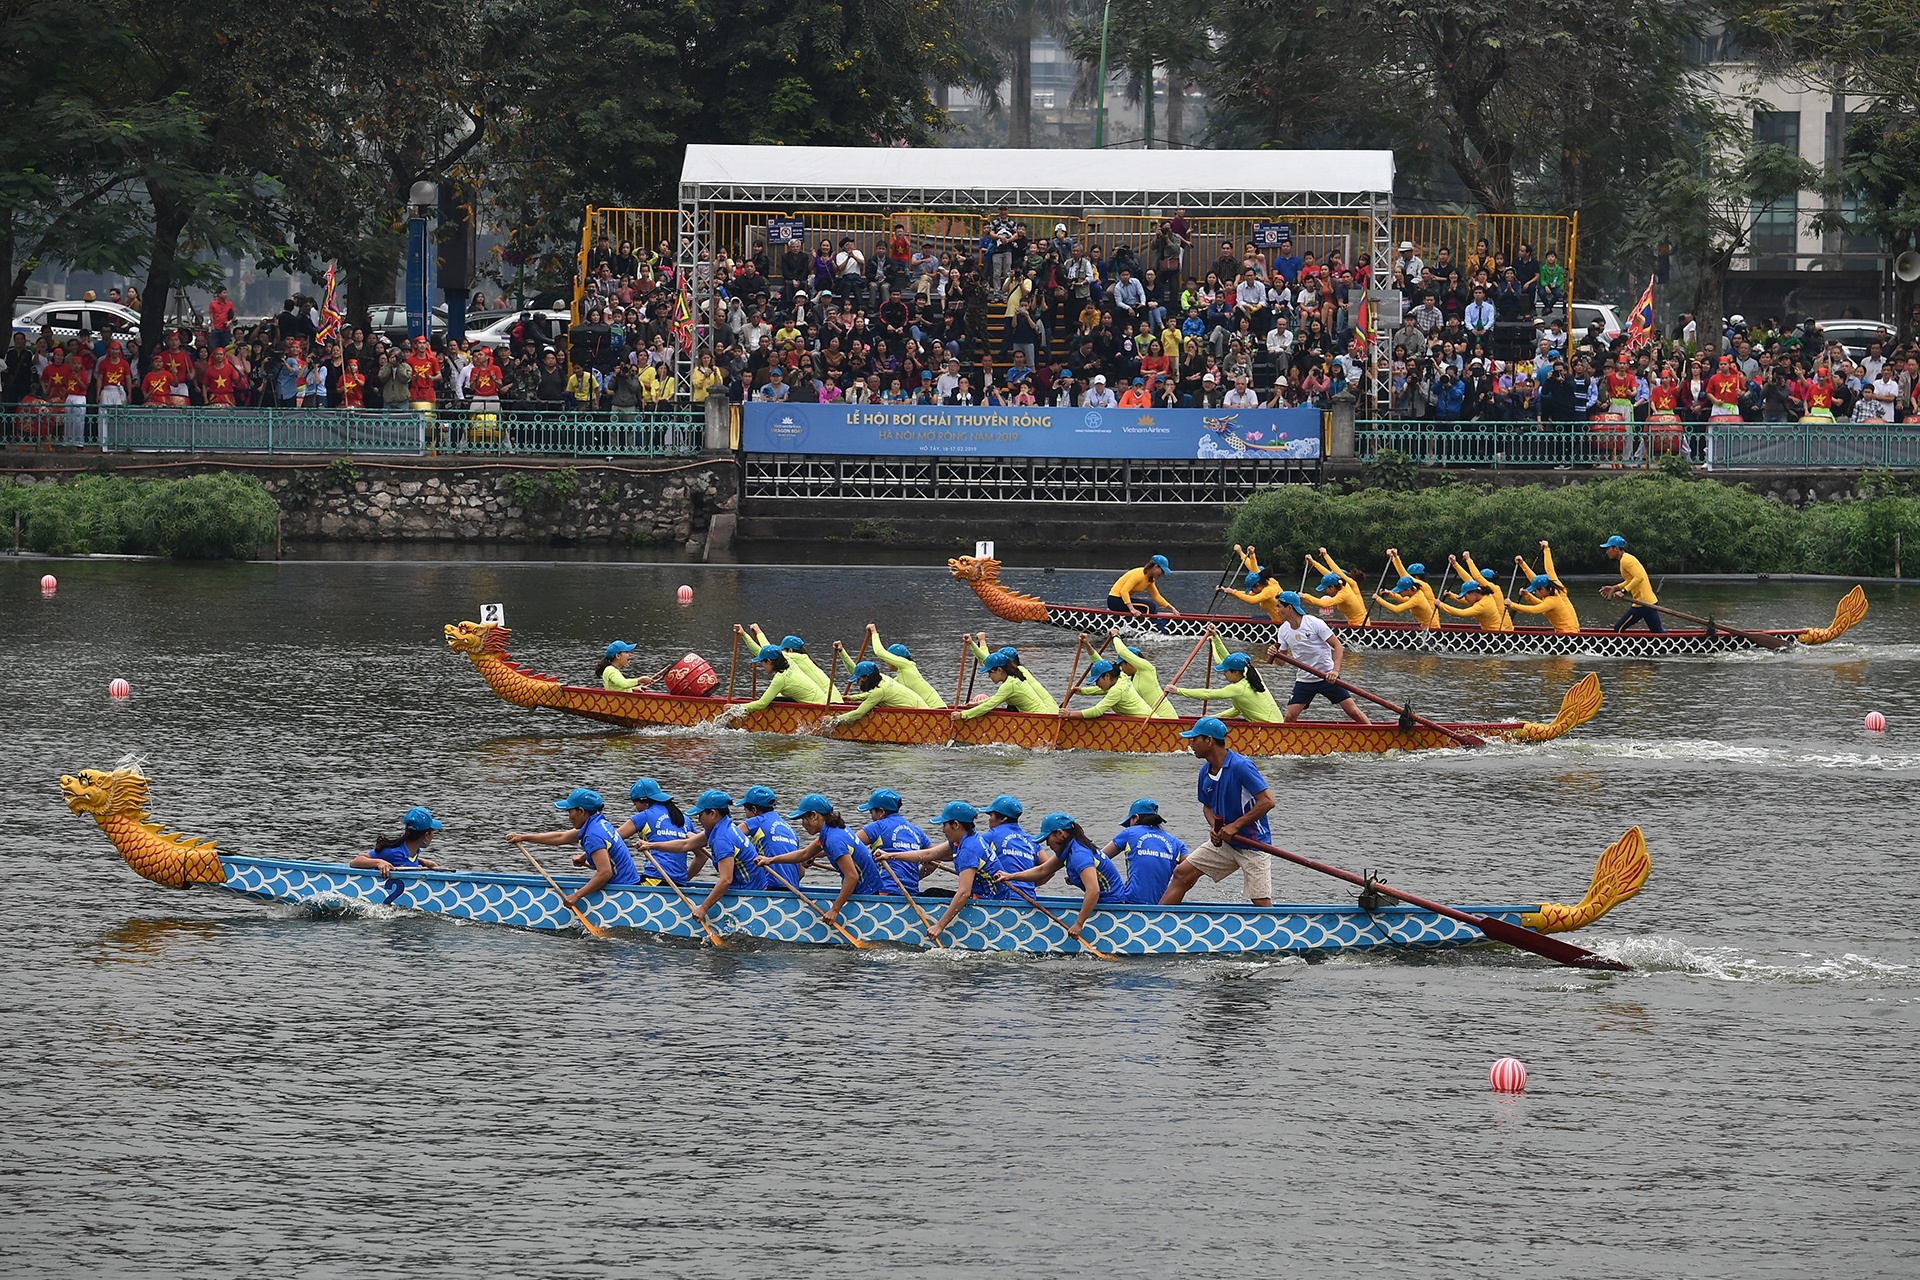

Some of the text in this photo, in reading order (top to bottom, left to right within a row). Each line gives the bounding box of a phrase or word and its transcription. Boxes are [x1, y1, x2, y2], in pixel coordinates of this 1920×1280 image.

[846, 408, 1051, 428] LỄ HỘI BƠI CHẢI THUYỀN RỒNG
[878, 429, 893, 440] HÀ
[895, 429, 914, 441] NỘI
[917, 430, 936, 441] MỞ
[970, 430, 994, 441] NĂM
[997, 431, 1019, 442] 2019
[981, 542, 987, 554] 1
[486, 605, 498, 621] 2
[1137, 848, 1159, 857] QUẢNG
[383, 879, 404, 904] 2
